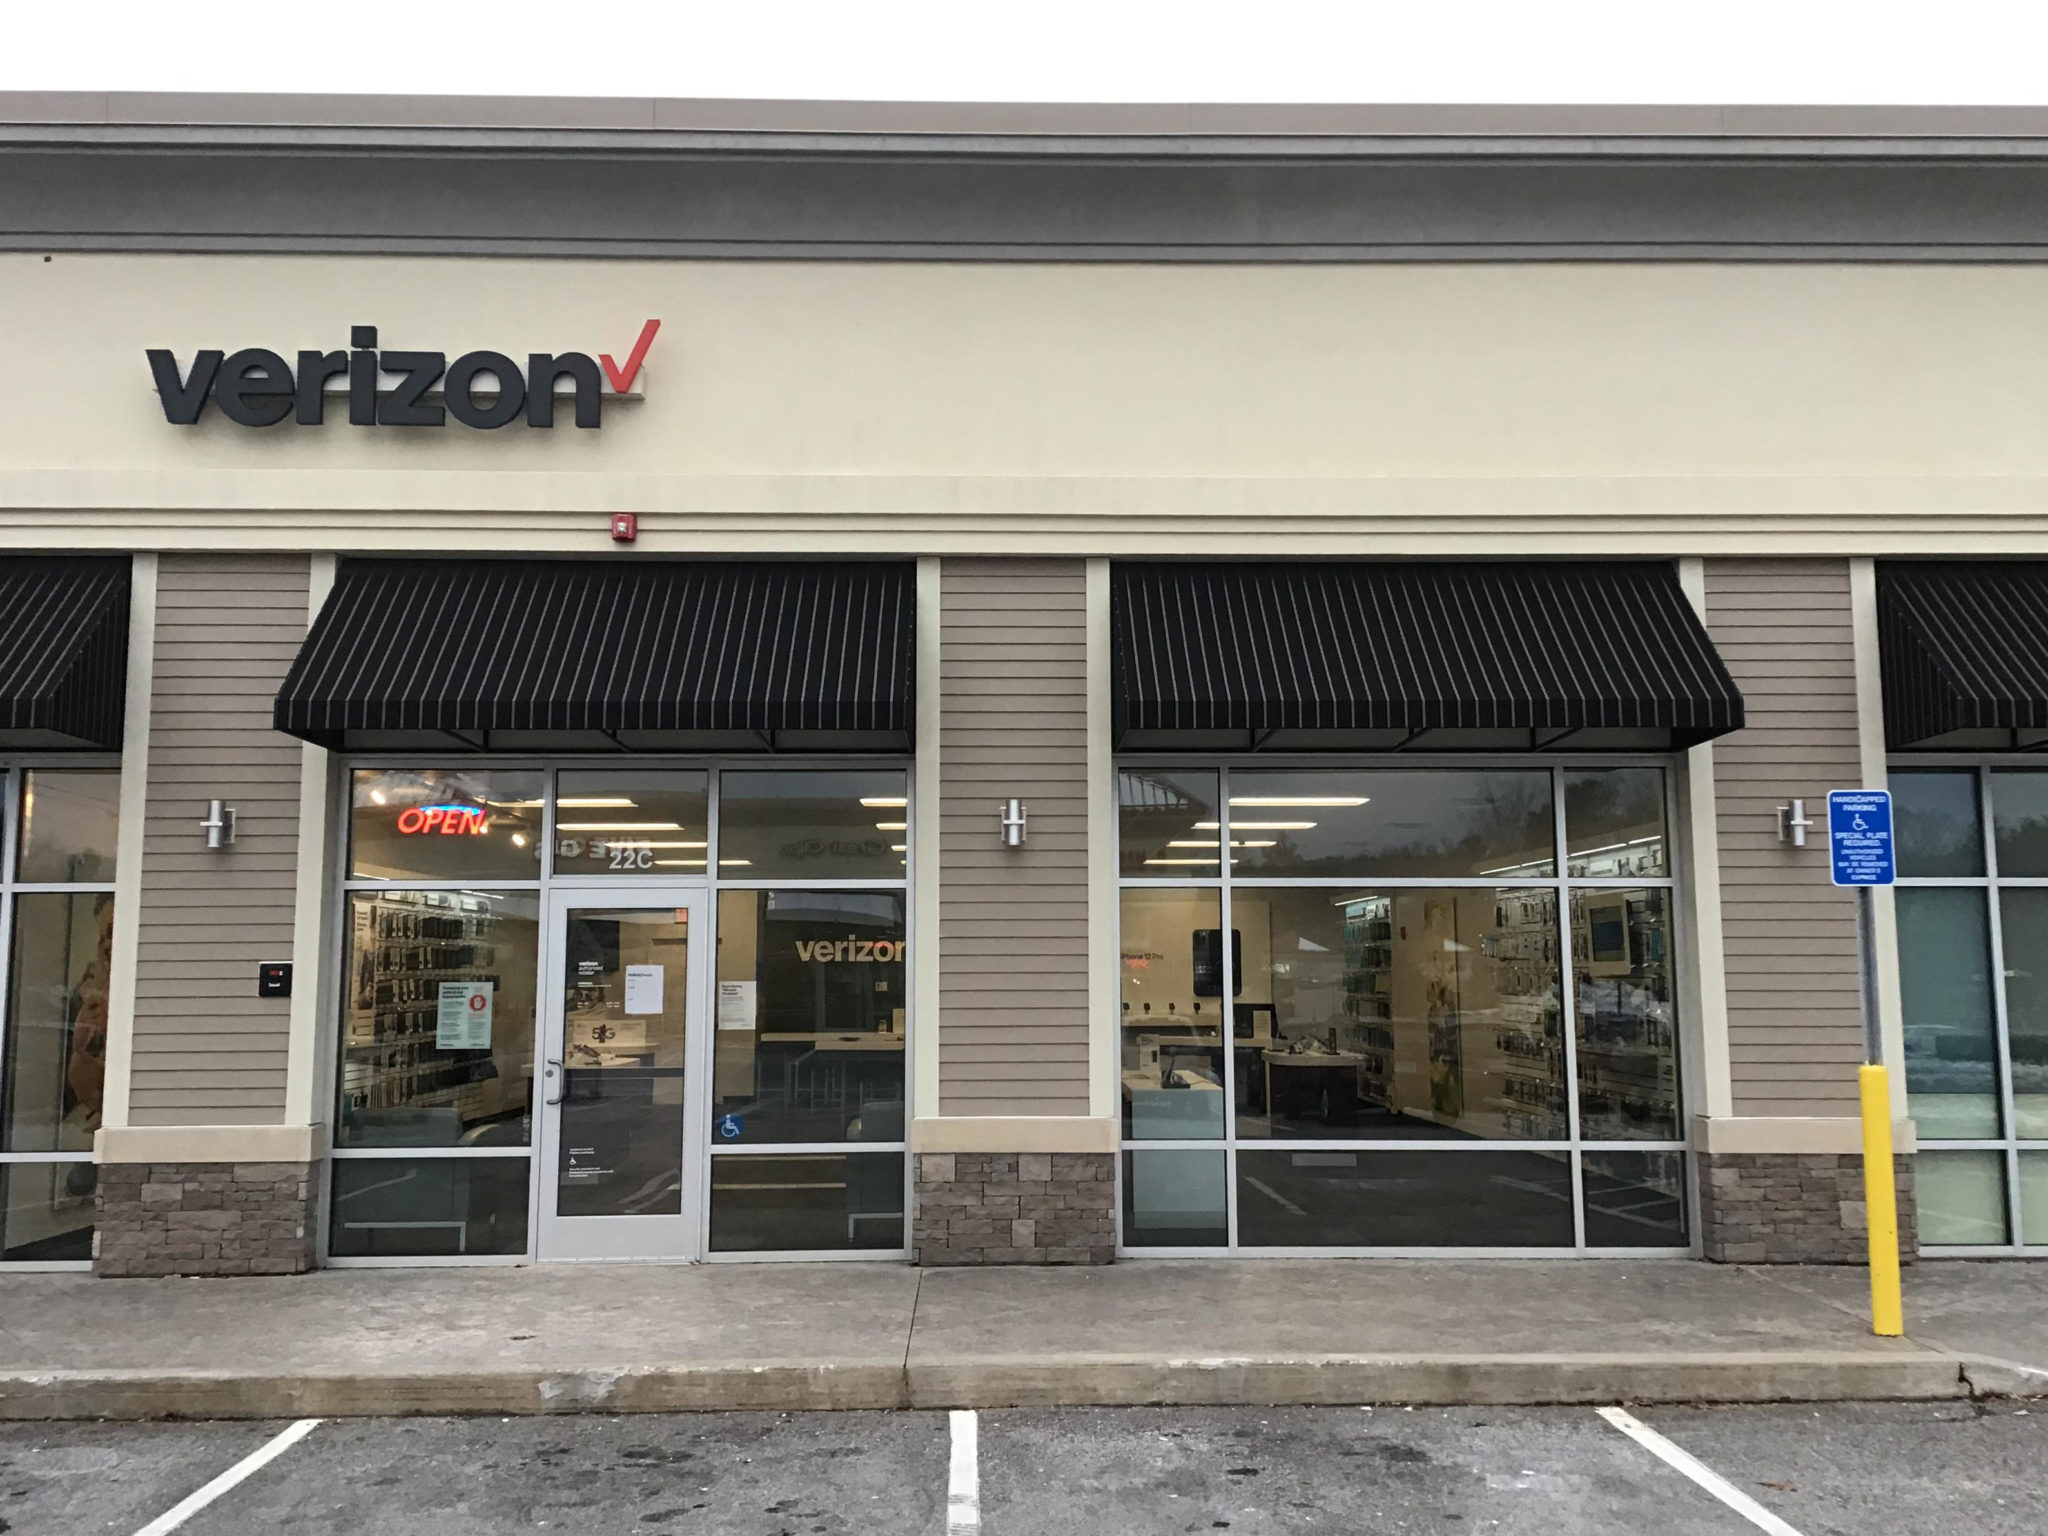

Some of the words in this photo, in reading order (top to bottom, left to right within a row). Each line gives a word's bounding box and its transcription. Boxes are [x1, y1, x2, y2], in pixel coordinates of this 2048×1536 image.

[145, 325, 601, 430] verizon
[1832, 795, 1887, 803] HANDICAPPED
[1843, 804, 1877, 812] PARKING
[397, 807, 486, 835] OPEN
[609, 850, 653, 870] 22C
